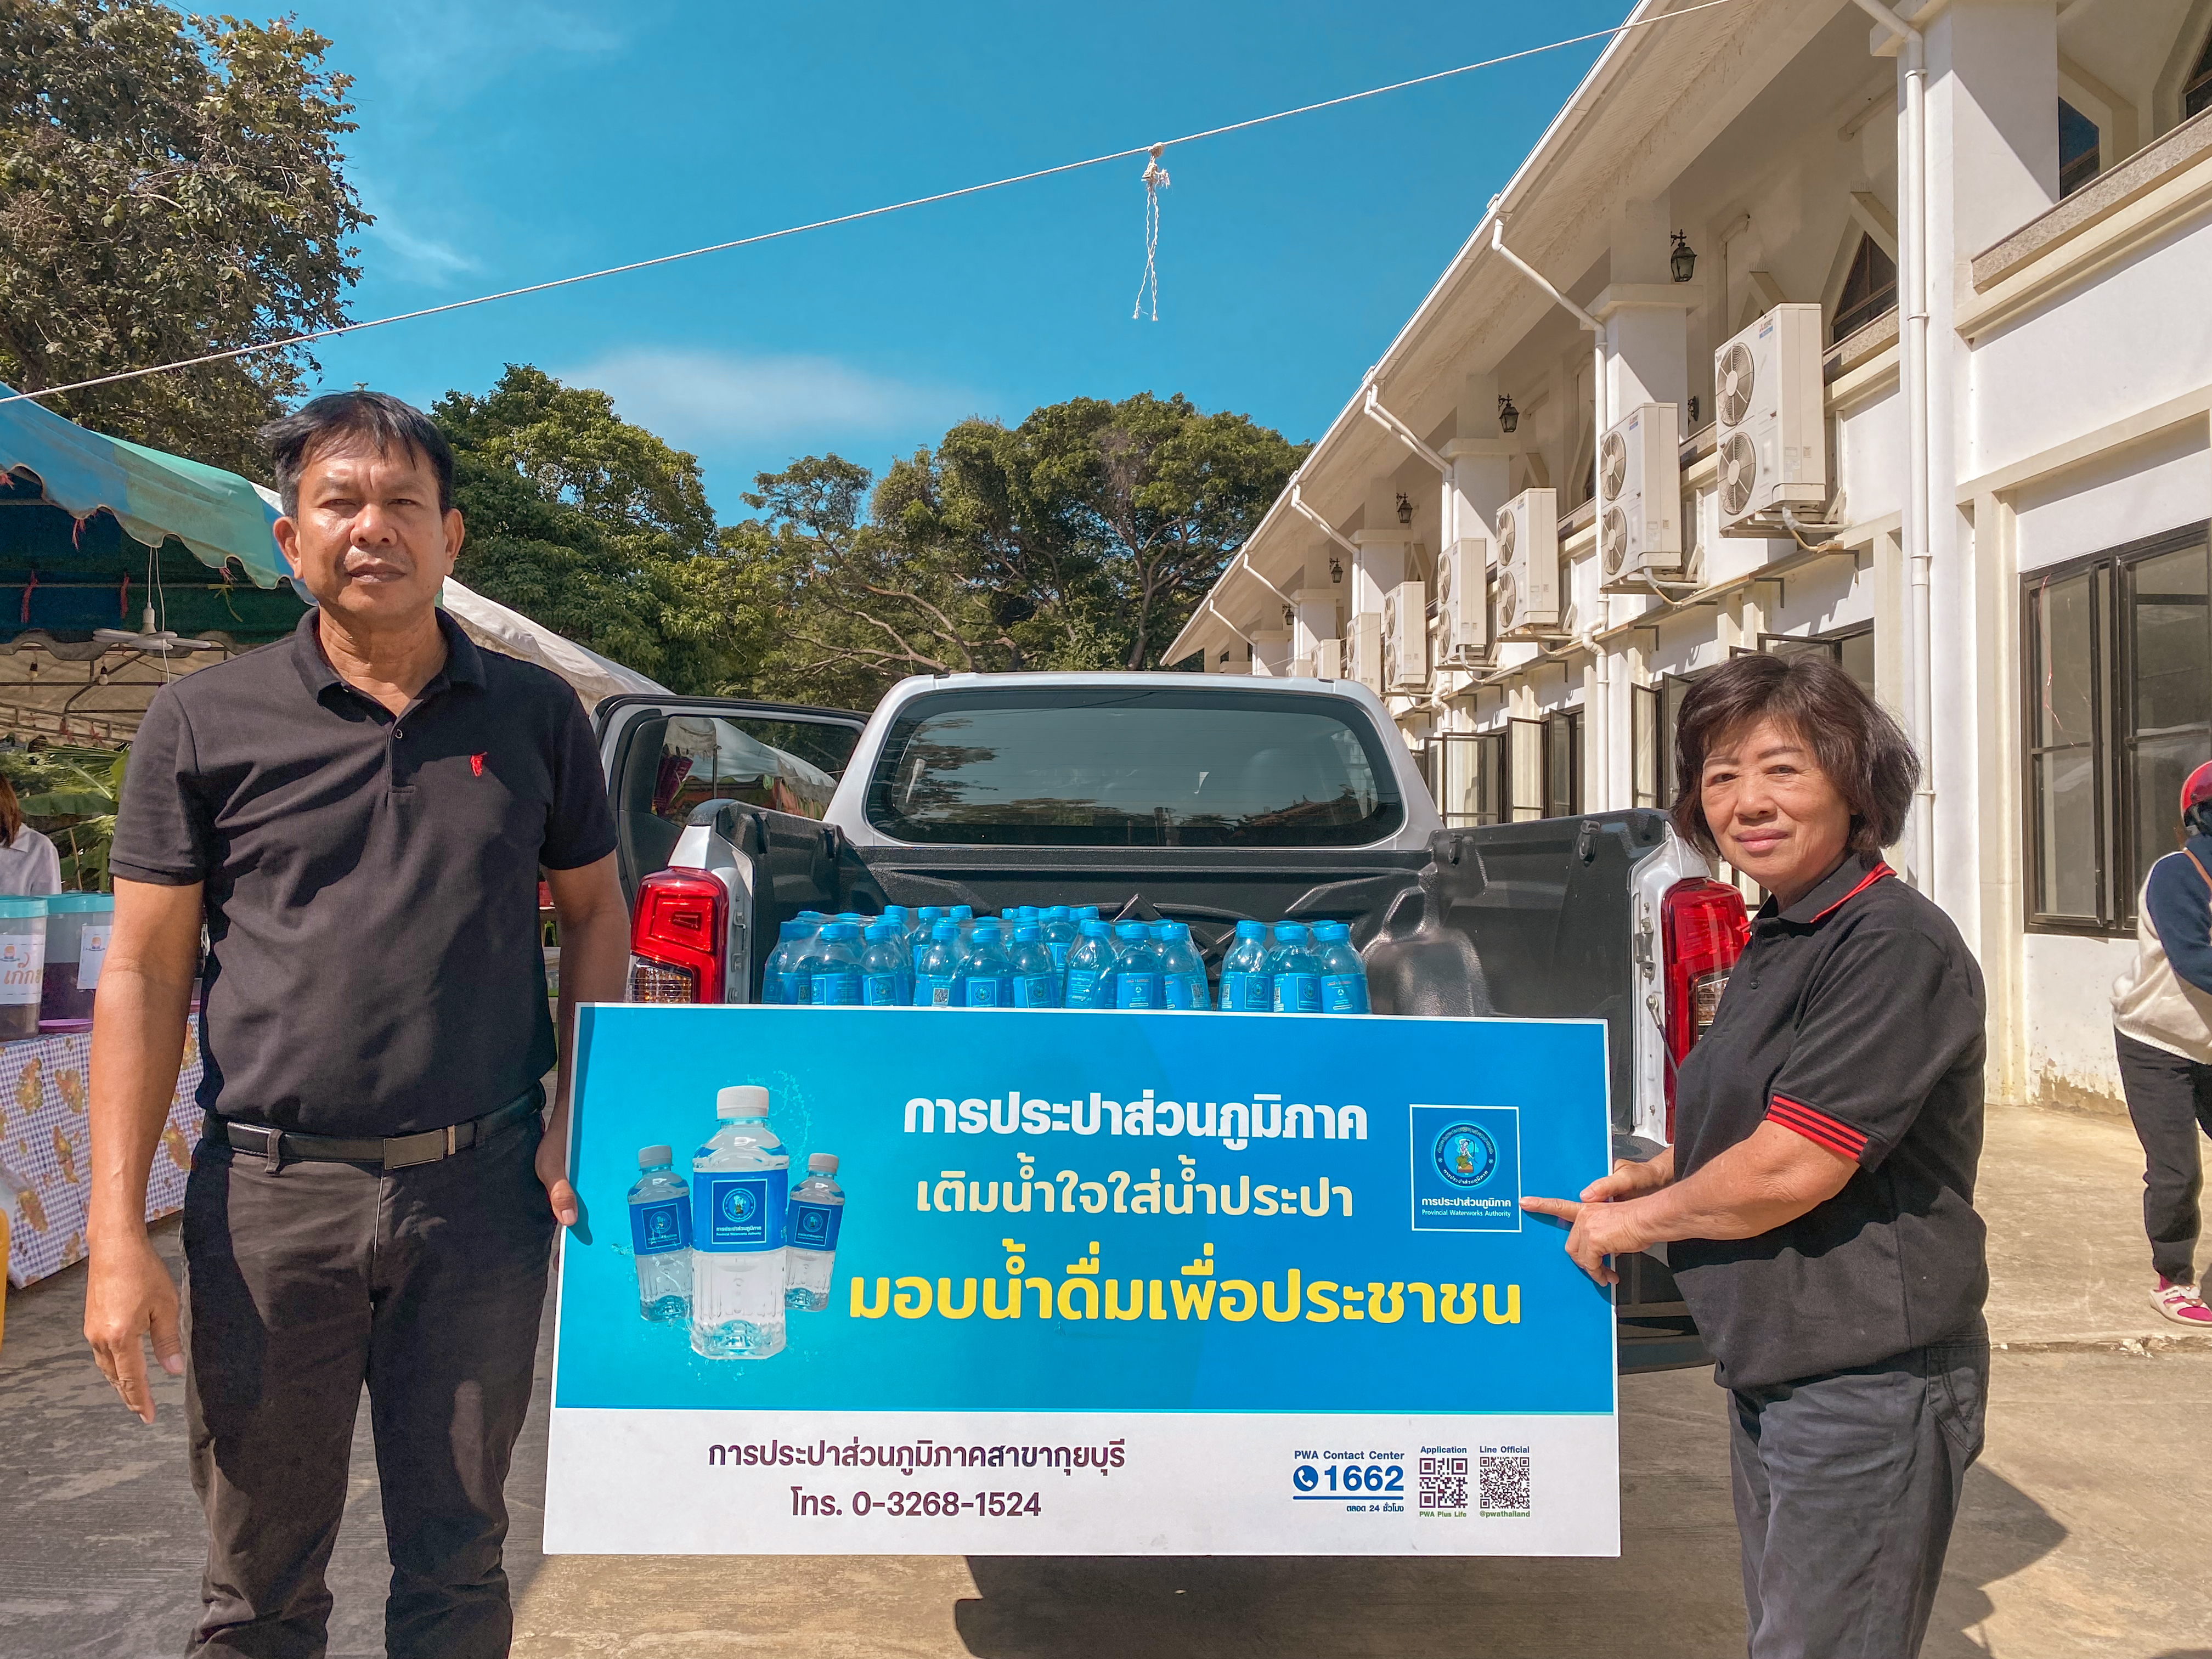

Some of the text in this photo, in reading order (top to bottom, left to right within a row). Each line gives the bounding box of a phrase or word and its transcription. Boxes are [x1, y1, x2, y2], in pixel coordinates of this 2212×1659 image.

[904, 1089, 1368, 1151] การประปาส่วนภูมิภาค
[917, 1153, 1353, 1217] เติมน้ำใจใส่น้ำประปา
[1421, 1197, 1511, 1209] การประปาส่วนภูมิภาค
[850, 1238, 1521, 1325] มอบน้ำดื่มเพื่อประชาชน
[709, 1436, 1126, 1476] การประปาส่วนภูมิภาคสาขากุยบุรี
[1294, 1450, 1405, 1460] PWA Contact Center
[1420, 1446, 1467, 1455] Application
[1324, 1465, 1404, 1492] 1662
[790, 1486, 1042, 1516] โทร. 0-3268-1524
[1383, 1502, 1404, 1513] ชั่วโมง
[1479, 1510, 1531, 1519] @pwathailand
